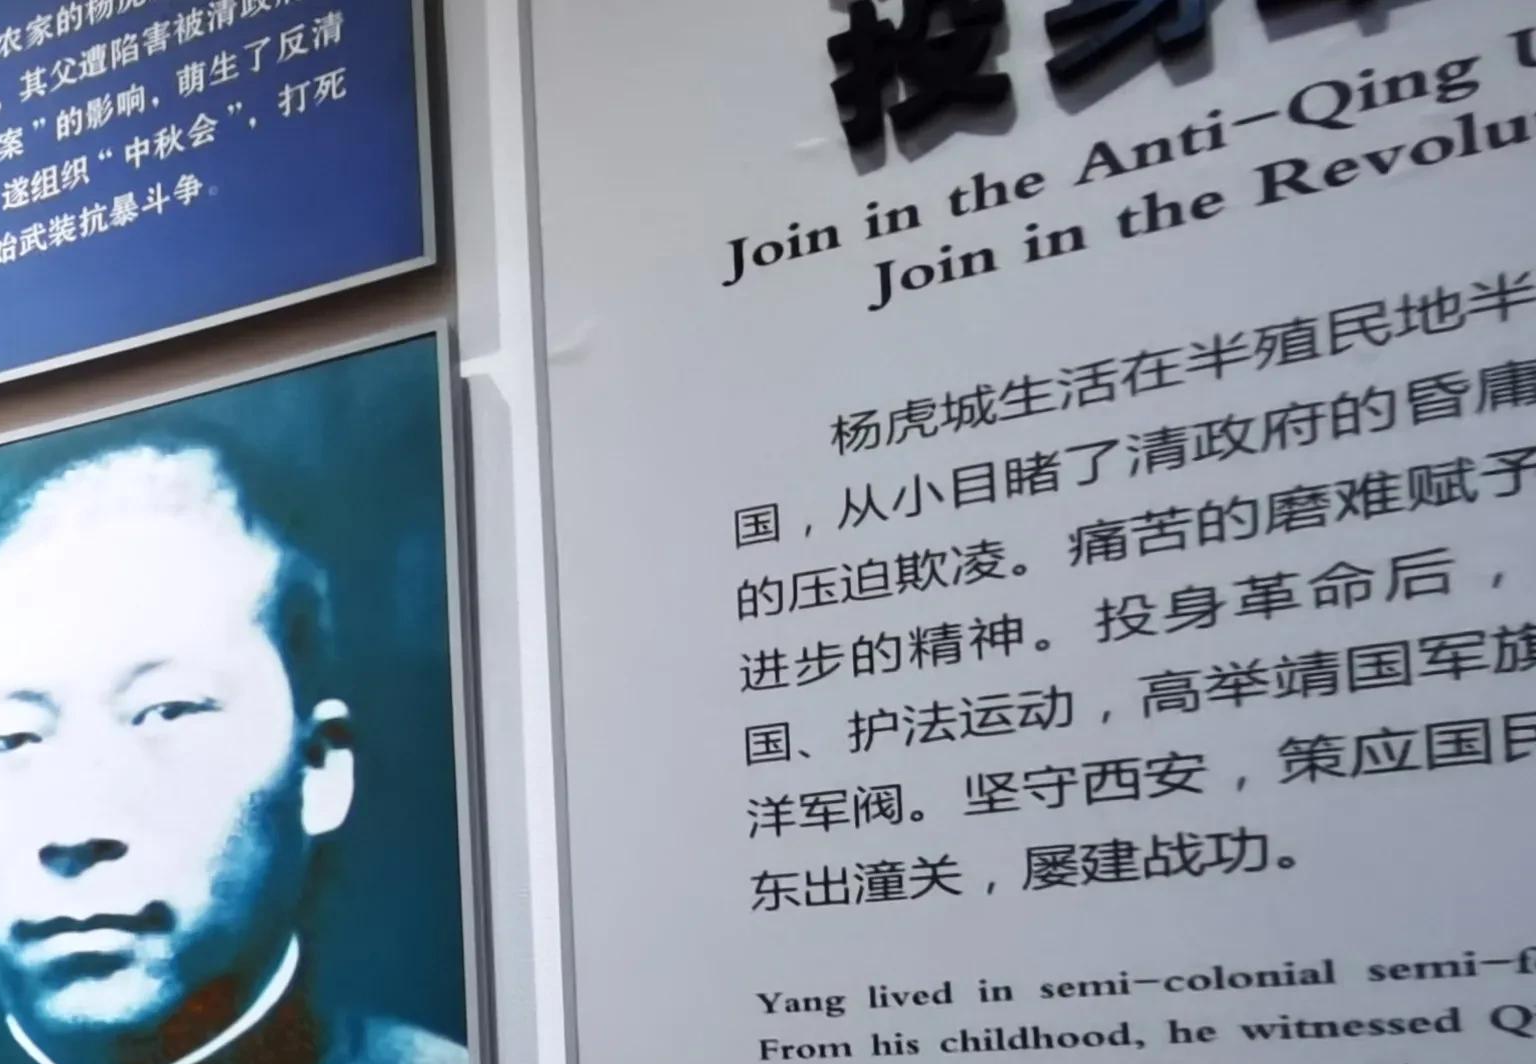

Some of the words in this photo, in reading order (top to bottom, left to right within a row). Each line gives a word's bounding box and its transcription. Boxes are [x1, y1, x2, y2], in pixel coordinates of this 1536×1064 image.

[721, 222, 842, 287] Join
[865, 201, 922, 240] in
[948, 172, 1046, 217] the
[867, 244, 999, 312] Join
[1024, 223, 1088, 263] in
[1116, 192, 1225, 239] the
[1253, 112, 1536, 206] Revolu
[830, 271, 1536, 456] 杨虎城生活在半殖民地半
[750, 826, 1296, 911] 东出潼关，屡建战功。
[755, 992, 846, 1018] Yang
[868, 980, 953, 1009] lived
[978, 978, 1013, 1003] in
[1040, 958, 1336, 999] semi-colonial
[759, 1039, 852, 1061] From
[871, 1032, 920, 1056] his
[940, 1021, 1146, 1053] childhood,
[1167, 1019, 1217, 1044] he
[1240, 1006, 1463, 1040] witnessed
[1489, 1005, 1536, 1039] Q
